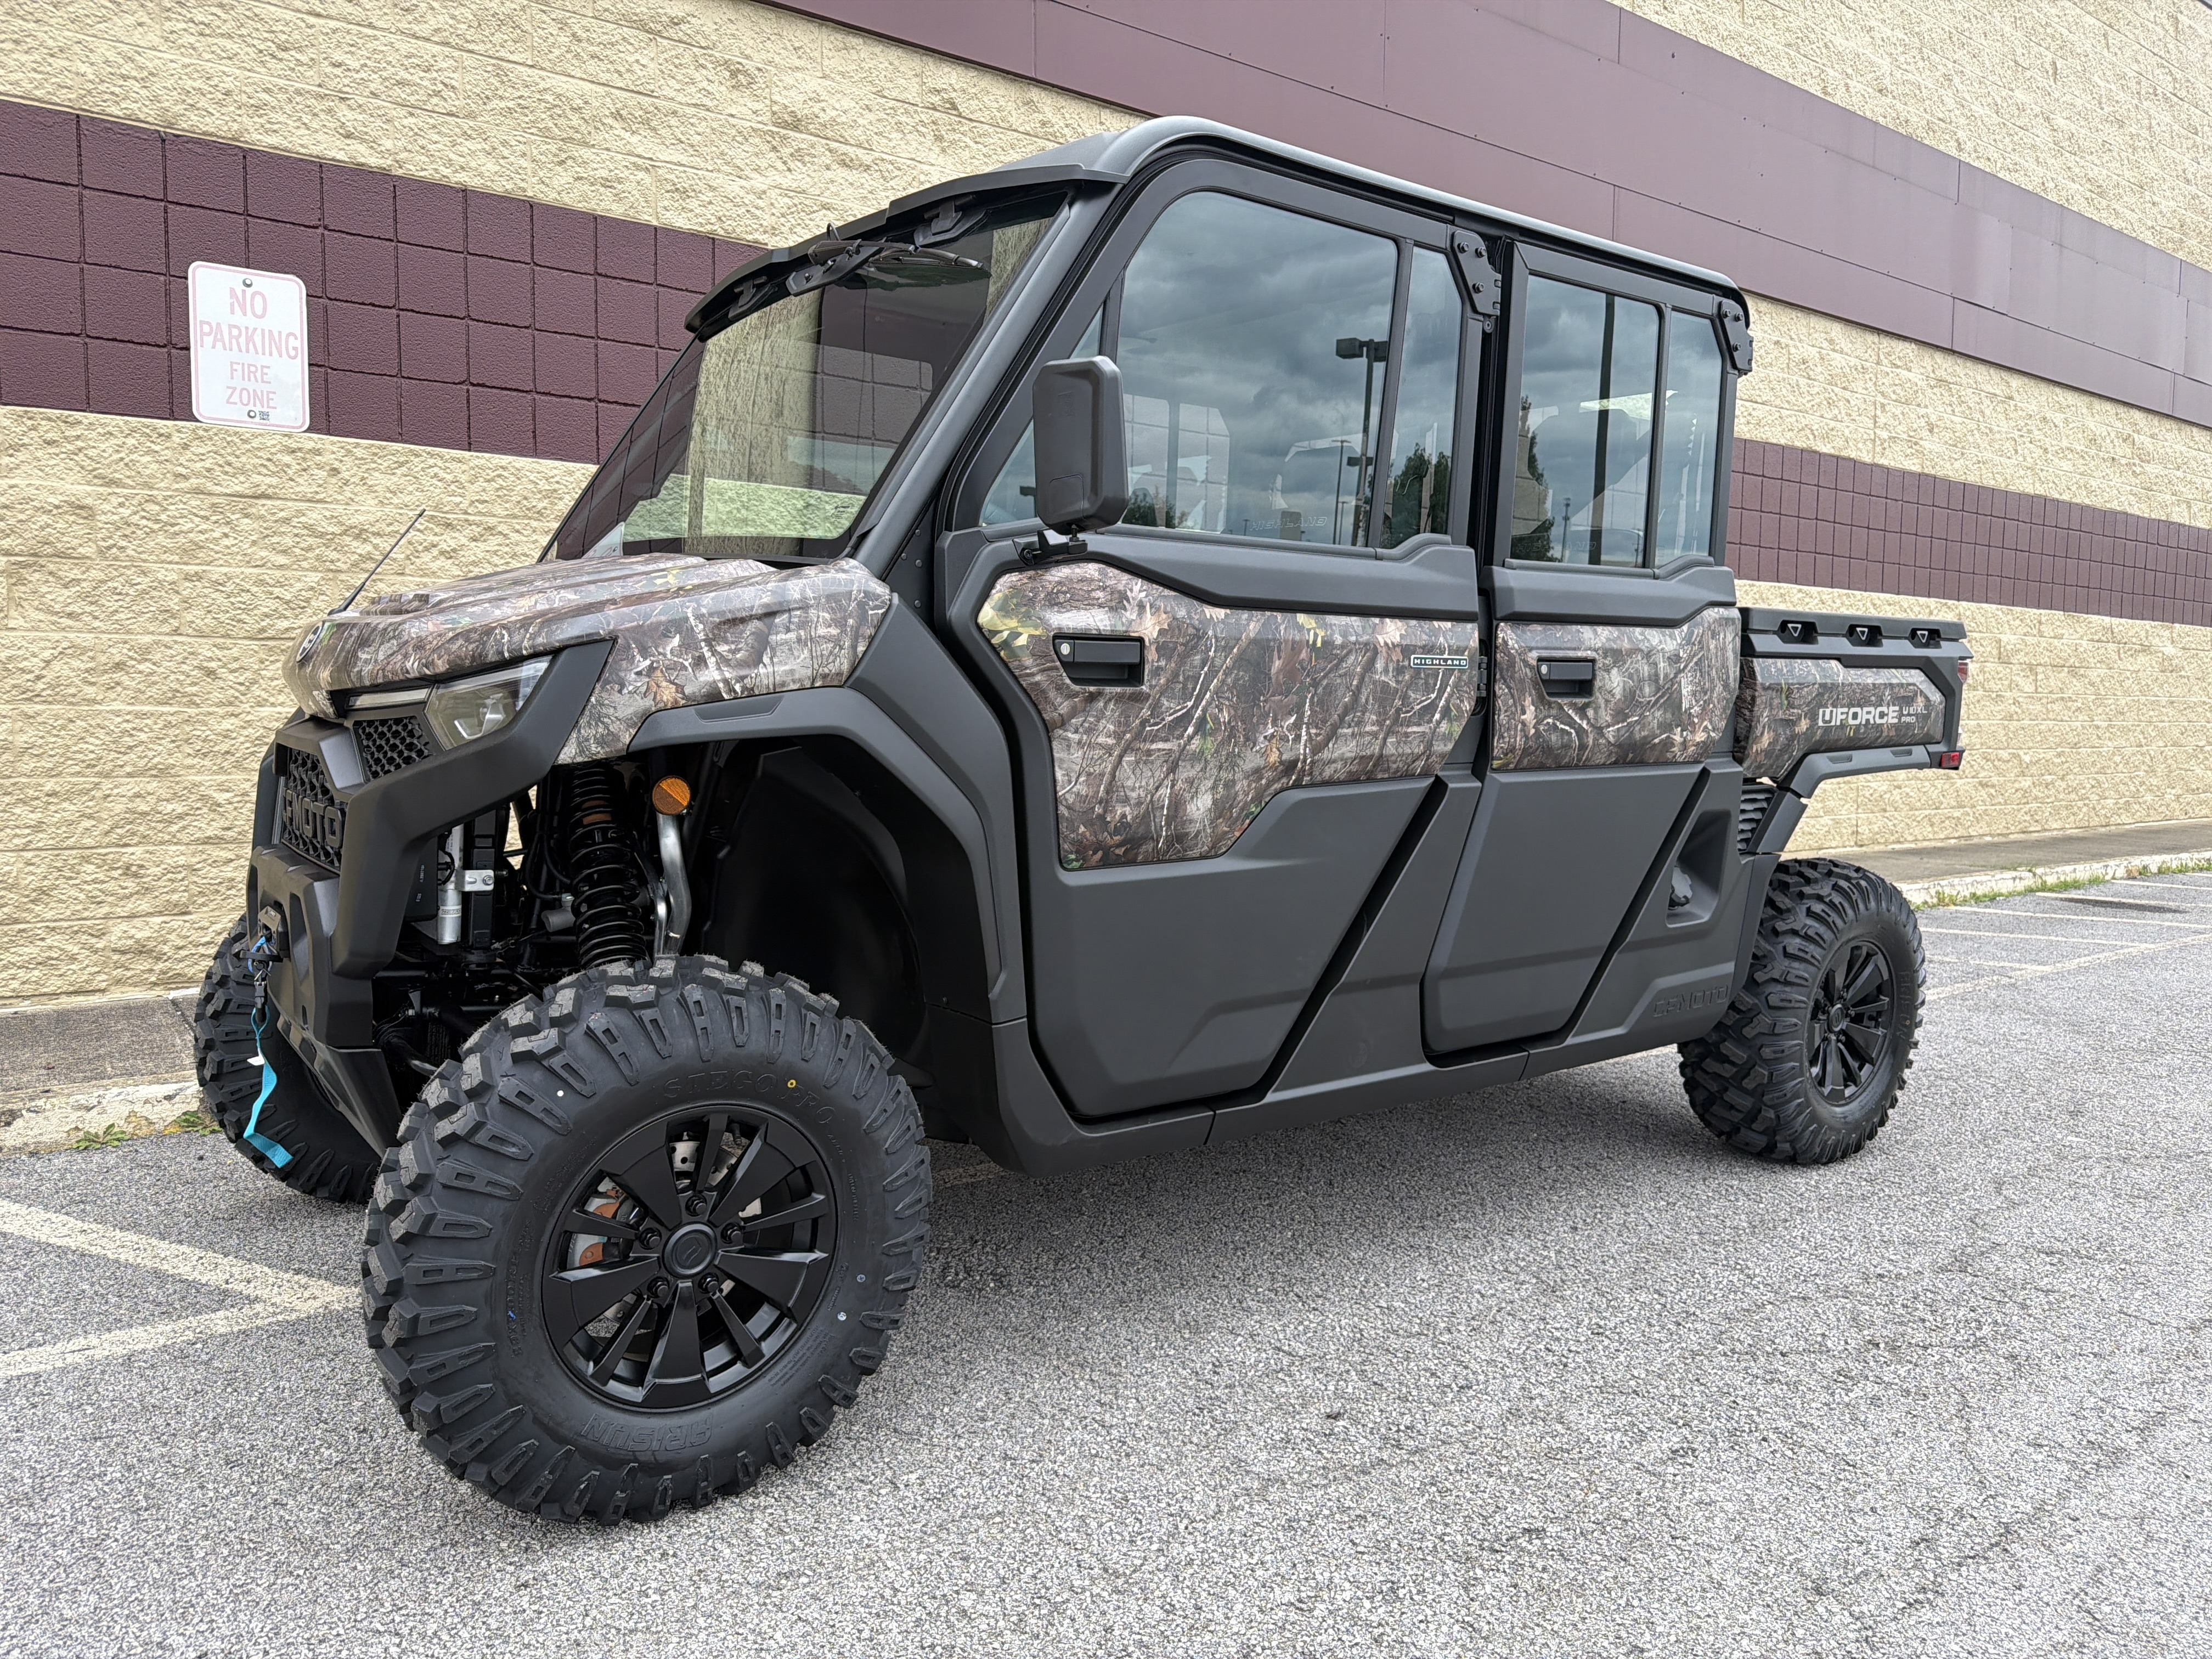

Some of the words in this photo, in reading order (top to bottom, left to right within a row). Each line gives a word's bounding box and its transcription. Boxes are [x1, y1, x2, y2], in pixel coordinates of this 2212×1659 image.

[229, 287, 267, 319] NO
[199, 320, 299, 360] PARKING
[229, 361, 272, 384] FIRE
[225, 386, 277, 410] ZONE
[1249, 516, 1328, 531] HIGHLAND
[1517, 541, 1597, 552] HIGHAND
[1818, 706, 1899, 726] UFORCE
[1652, 984, 1729, 1018] CFMOTO
[663, 1069, 778, 1098] STEGO
[776, 1083, 837, 1125] PRO
[579, 1412, 713, 1452] ARISUN
